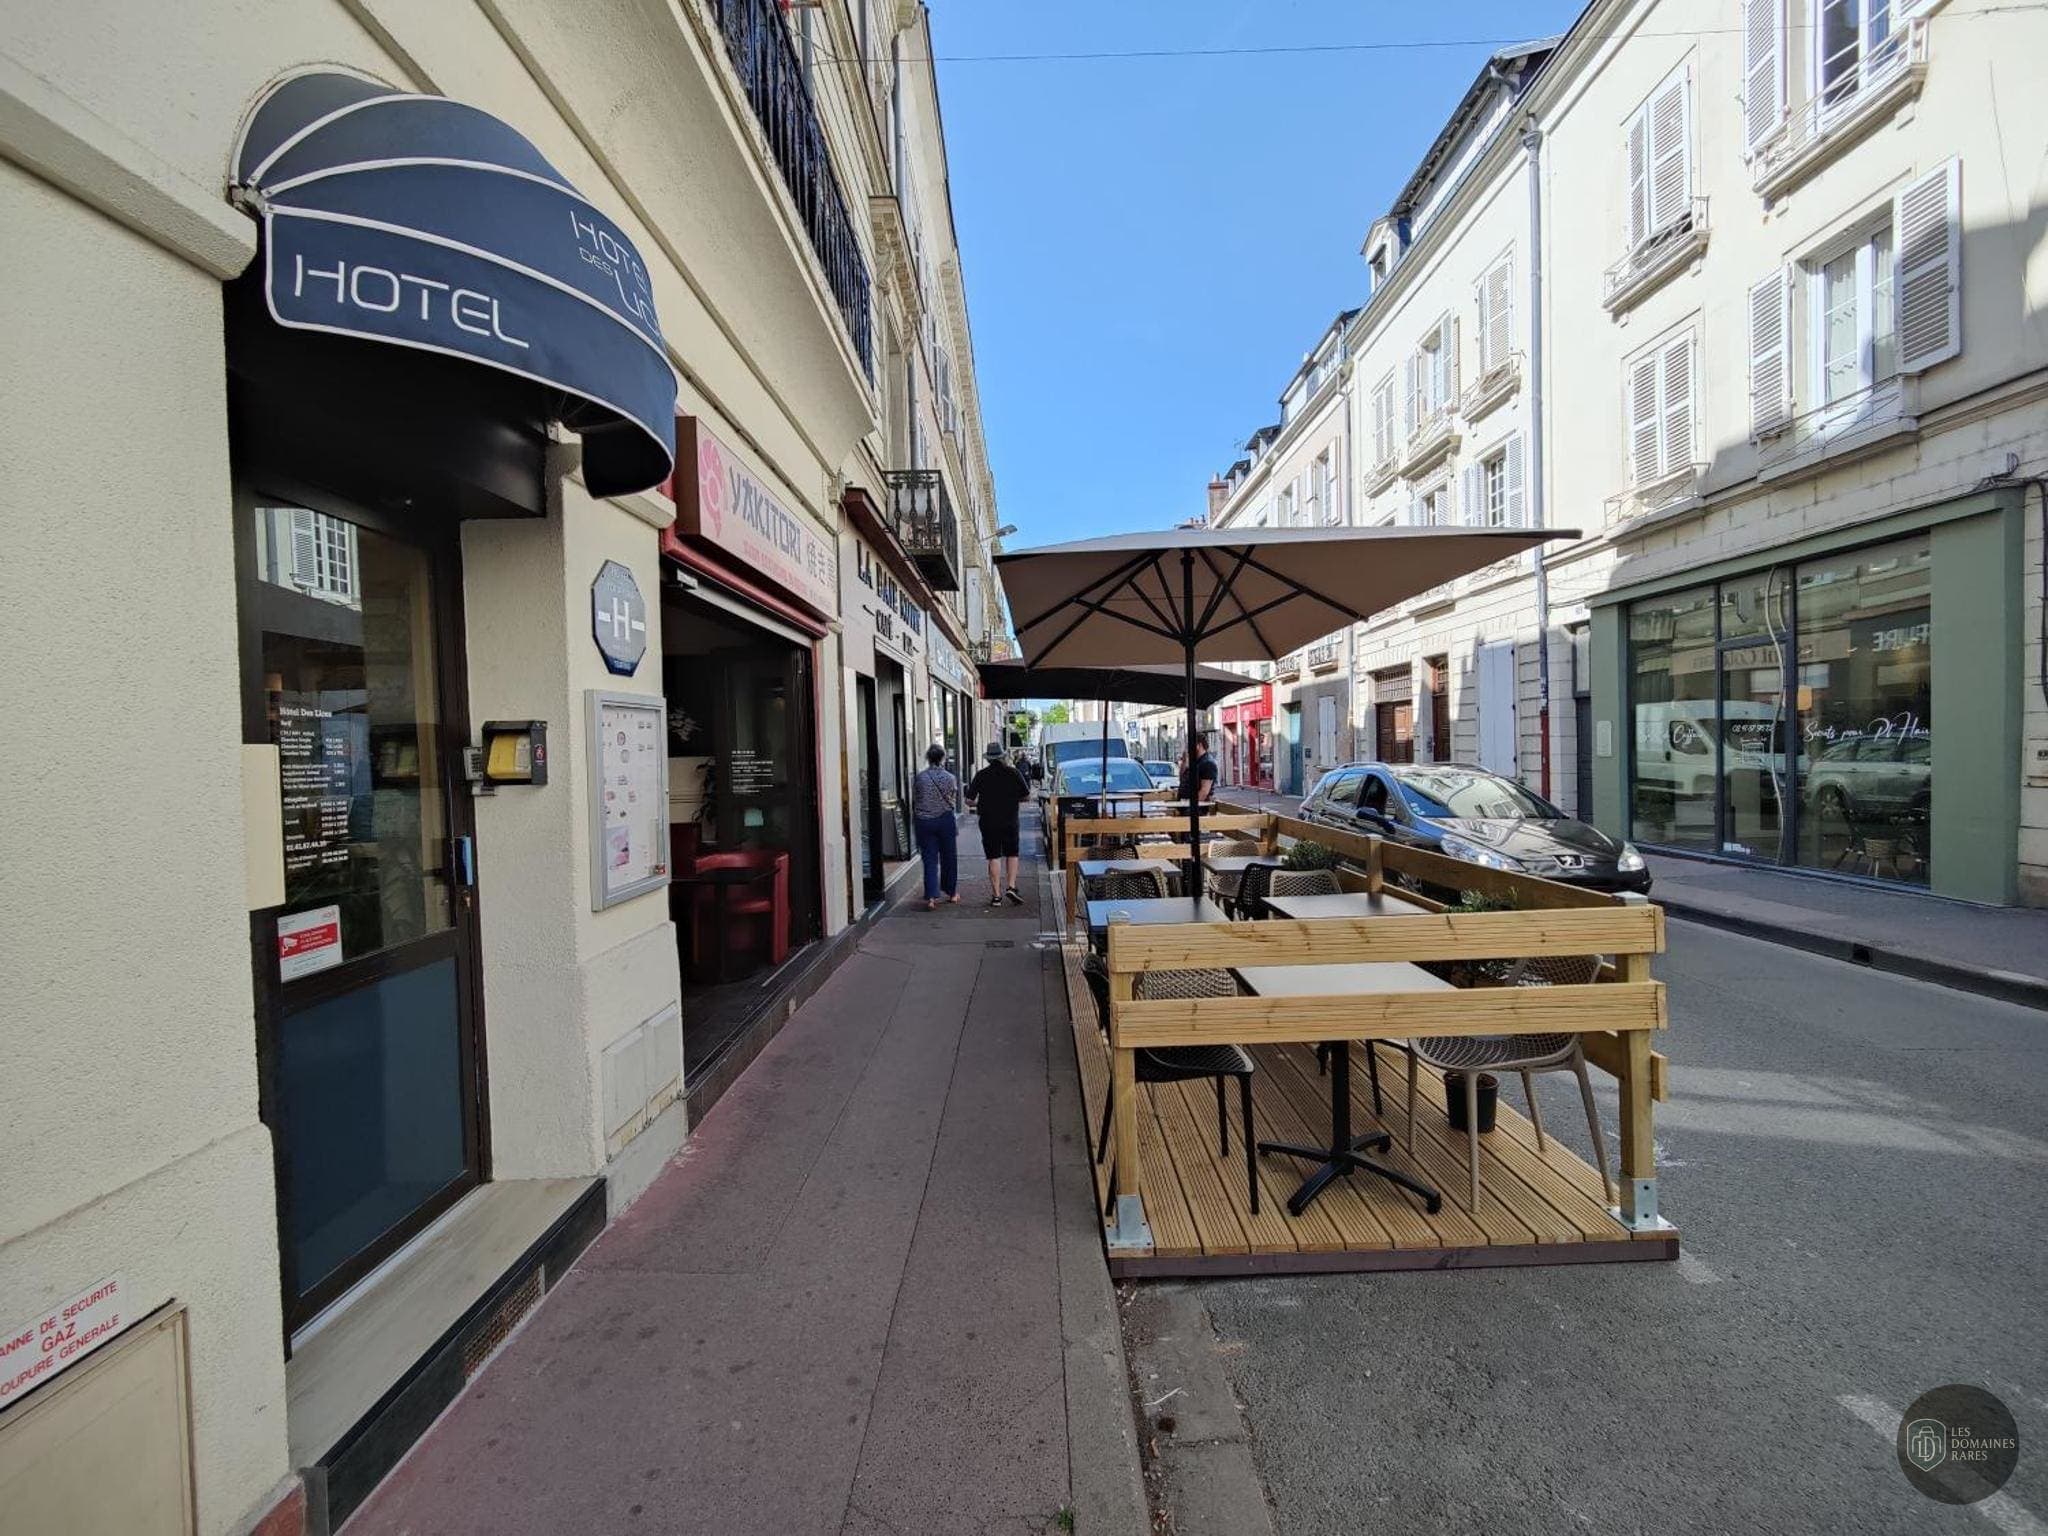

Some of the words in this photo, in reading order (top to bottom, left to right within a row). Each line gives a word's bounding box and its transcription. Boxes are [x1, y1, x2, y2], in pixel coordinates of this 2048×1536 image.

[579, 246, 614, 276] DES
[294, 253, 530, 349] HOTEL
[728, 464, 802, 565] YAKITORI
[612, 596, 631, 642] H
[300, 708, 314, 717] Des
[0, 1330, 34, 1357] ANNE
[40, 1315, 57, 1334] DE
[62, 1280, 118, 1321] SECURITE
[41, 1321, 77, 1353] GAZ
[0, 1354, 54, 1396] OUPURE
[59, 1313, 120, 1359] GENERALE
